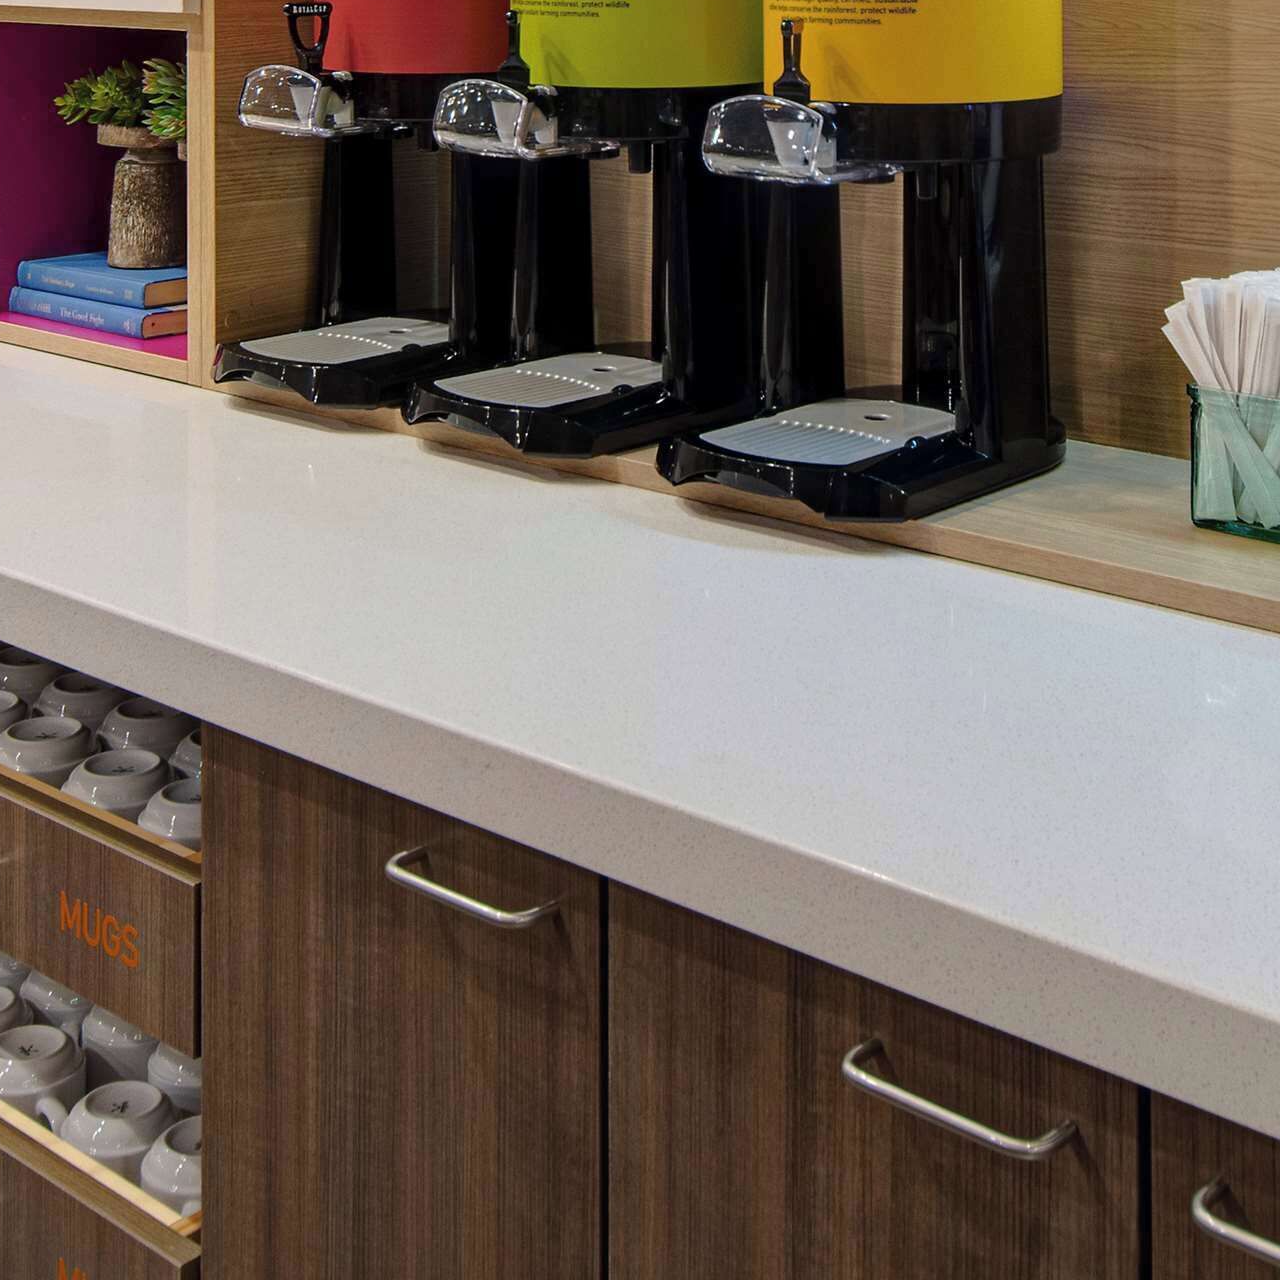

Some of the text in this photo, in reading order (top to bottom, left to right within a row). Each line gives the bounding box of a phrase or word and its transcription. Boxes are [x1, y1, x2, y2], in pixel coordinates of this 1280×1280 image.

[581, 1, 603, 9] protect
[860, 6, 886, 15] protect
[888, 6, 917, 15] wildlife
[59, 890, 139, 969] MUGS
